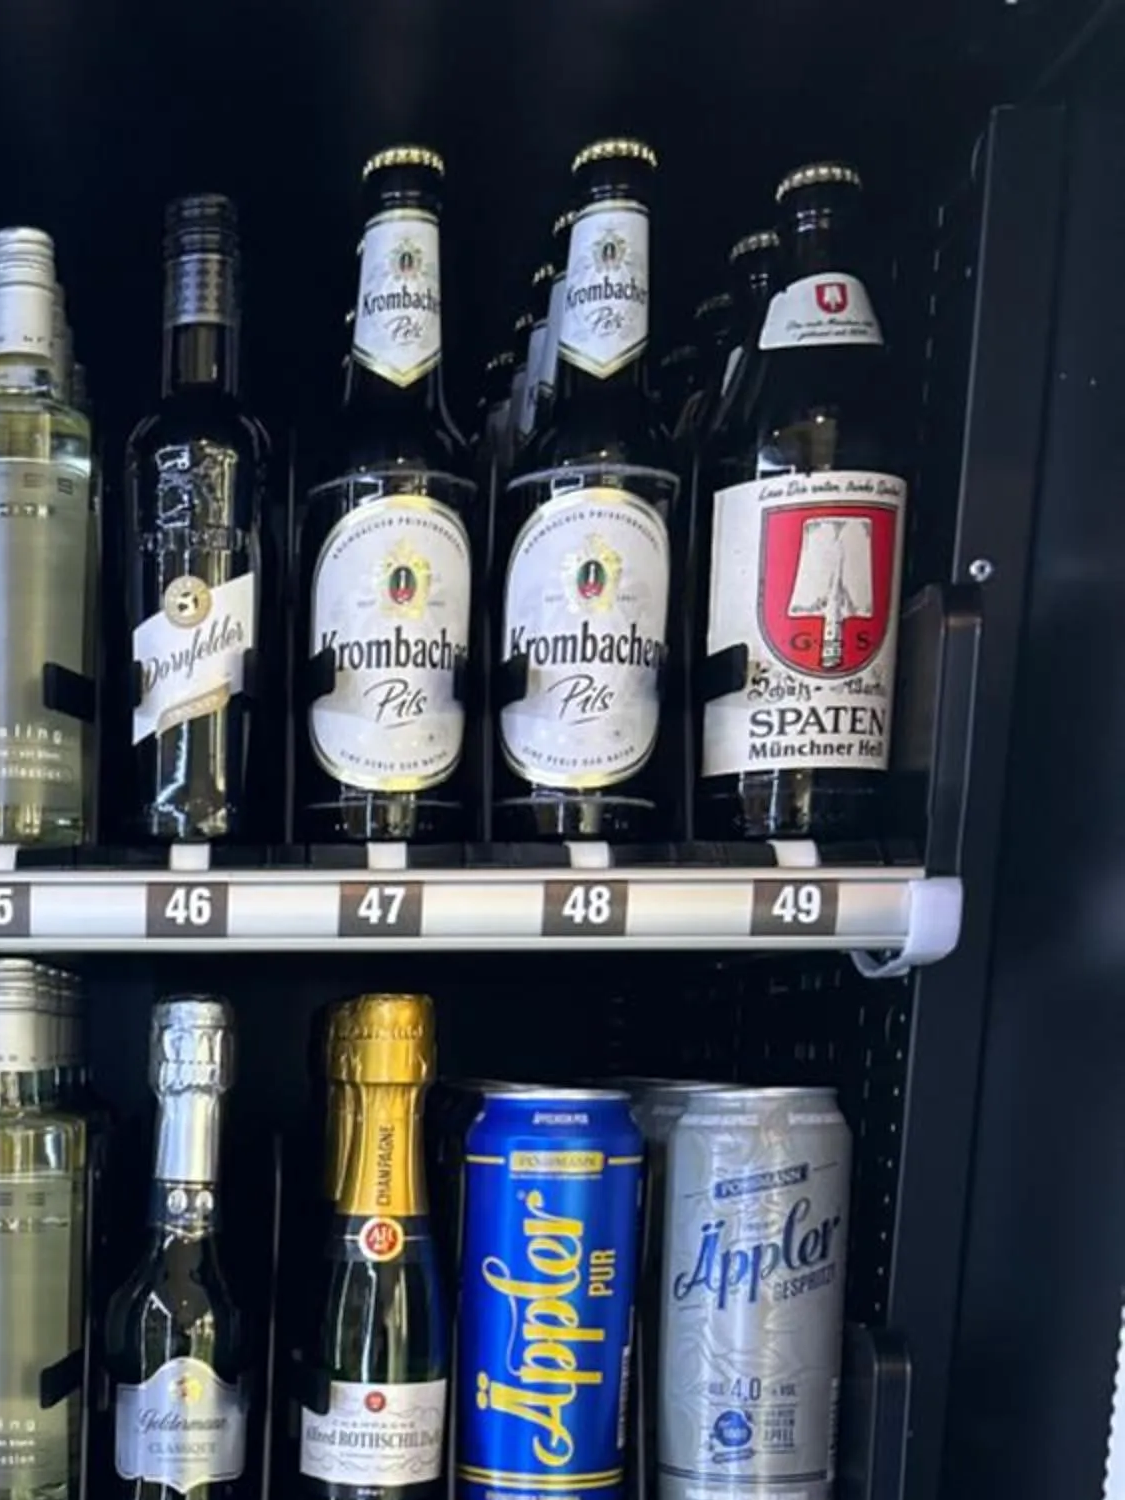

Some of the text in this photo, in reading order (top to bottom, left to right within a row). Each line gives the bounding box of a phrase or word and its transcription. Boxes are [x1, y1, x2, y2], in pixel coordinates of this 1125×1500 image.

[790, 631, 871, 652] G S
[363, 677, 428, 723] Pils
[547, 673, 616, 720] Pils
[748, 704, 886, 738] SPATEN
[748, 738, 854, 761] Münchner
[164, 886, 212, 926] 46
[357, 885, 408, 925] 47
[561, 884, 612, 924] 48
[770, 884, 822, 924] 49
[587, 1247, 616, 1298] PUR
[674, 1196, 841, 1310] Äppler
[476, 1188, 605, 1468] Äppler
